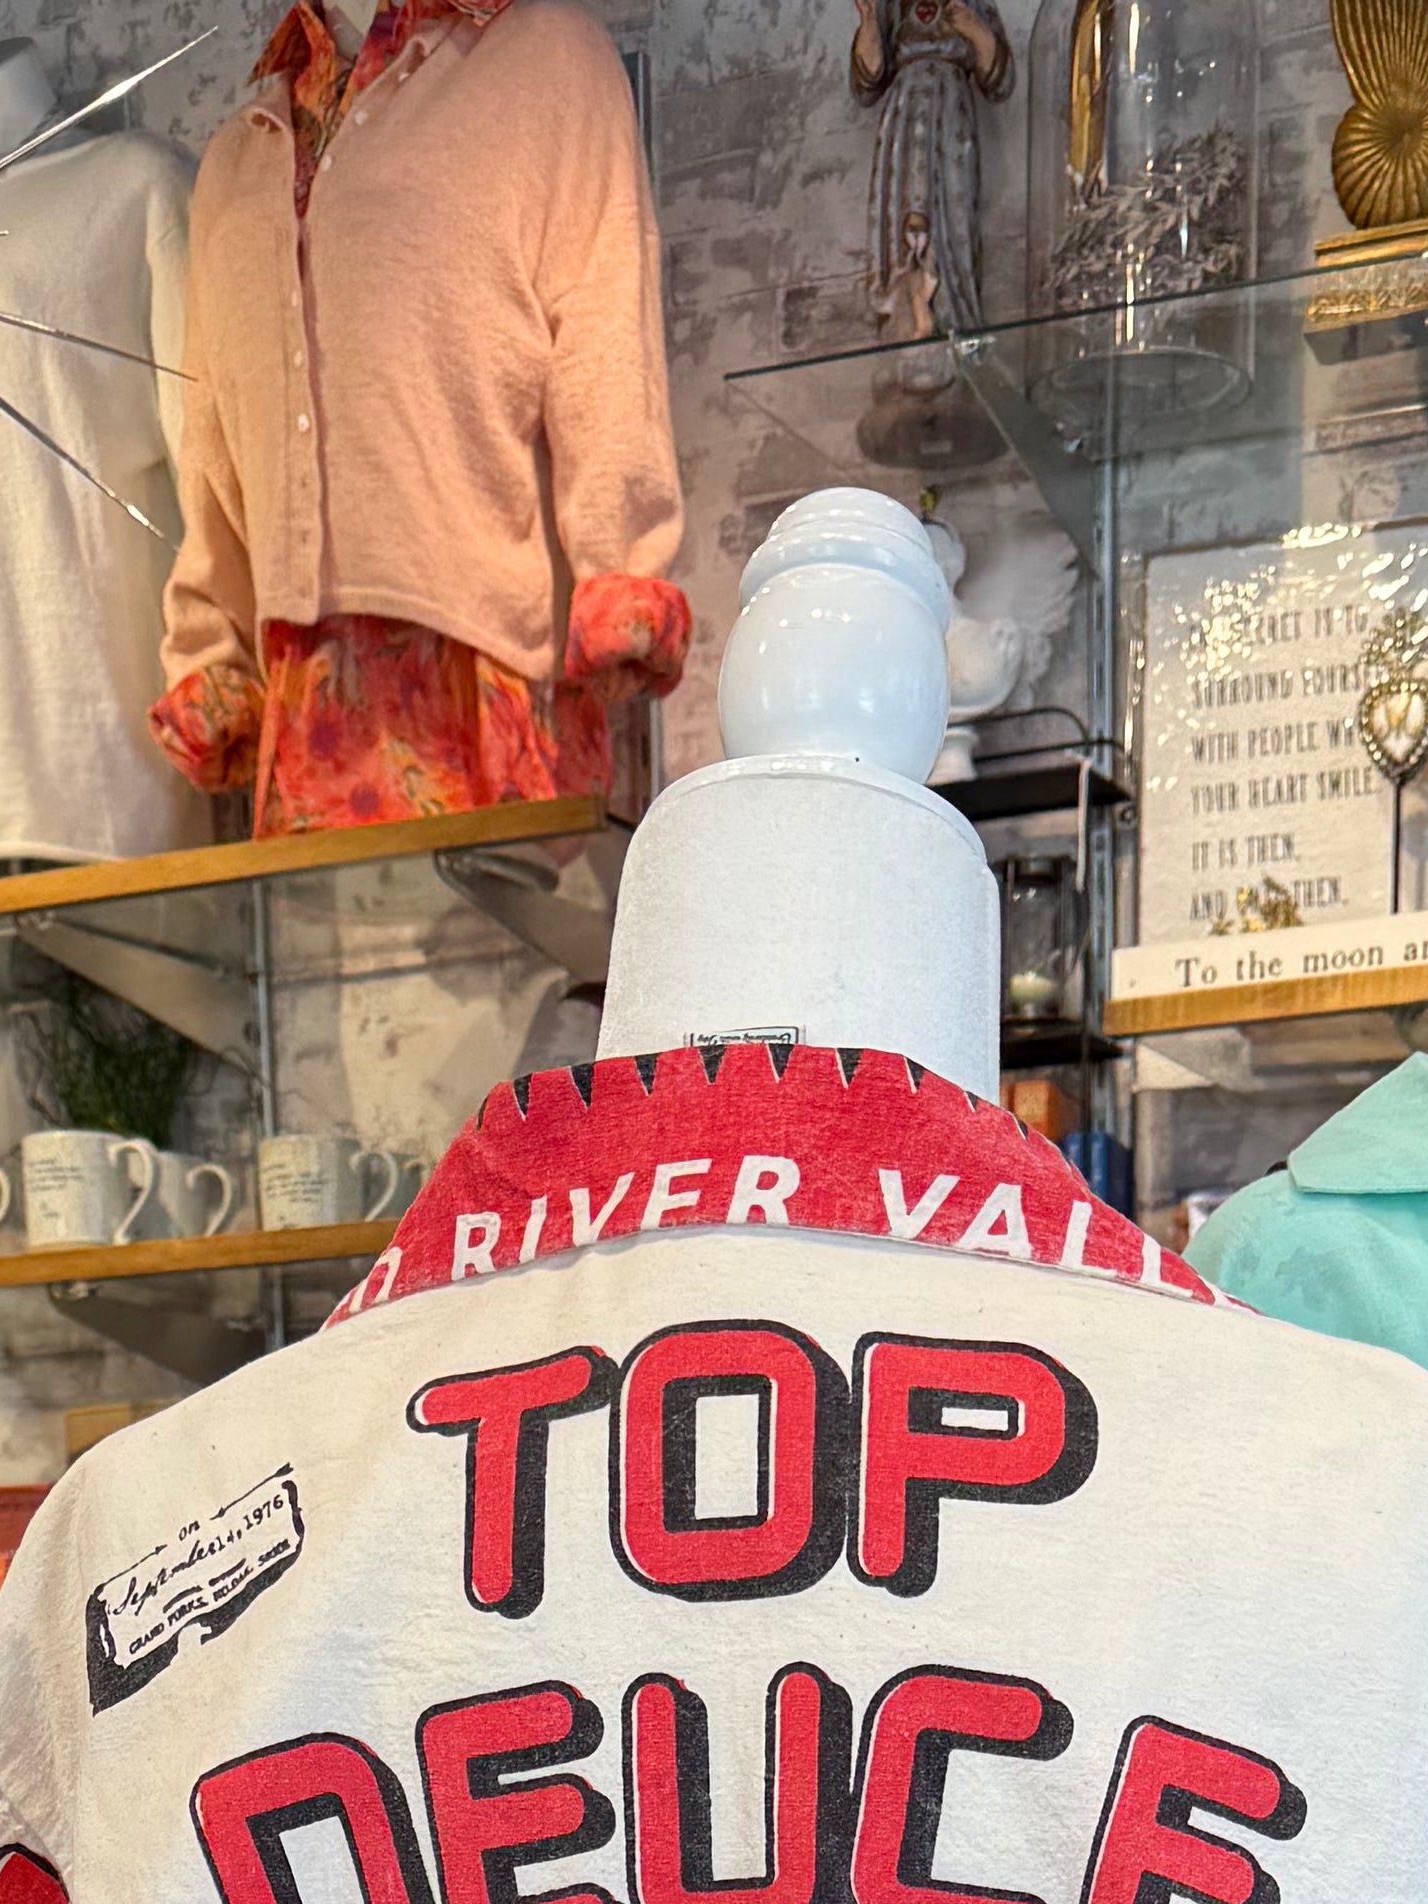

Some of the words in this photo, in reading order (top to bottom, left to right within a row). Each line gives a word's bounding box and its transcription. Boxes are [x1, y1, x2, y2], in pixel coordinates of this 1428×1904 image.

[1191, 729, 1240, 764] WITH
[1247, 721, 1321, 760] PEOPLE
[1191, 780, 1240, 815] YOUR
[1248, 773, 1308, 810] HEART
[1191, 841, 1210, 872] IT
[1218, 837, 1237, 868] IS
[1174, 956, 1218, 988] To
[1236, 950, 1284, 981] the
[1303, 945, 1384, 974] moon
[450, 1155, 798, 1284] RIVER
[406, 1319, 1100, 1620] TOP
[243, 1493, 285, 1531] 1976
